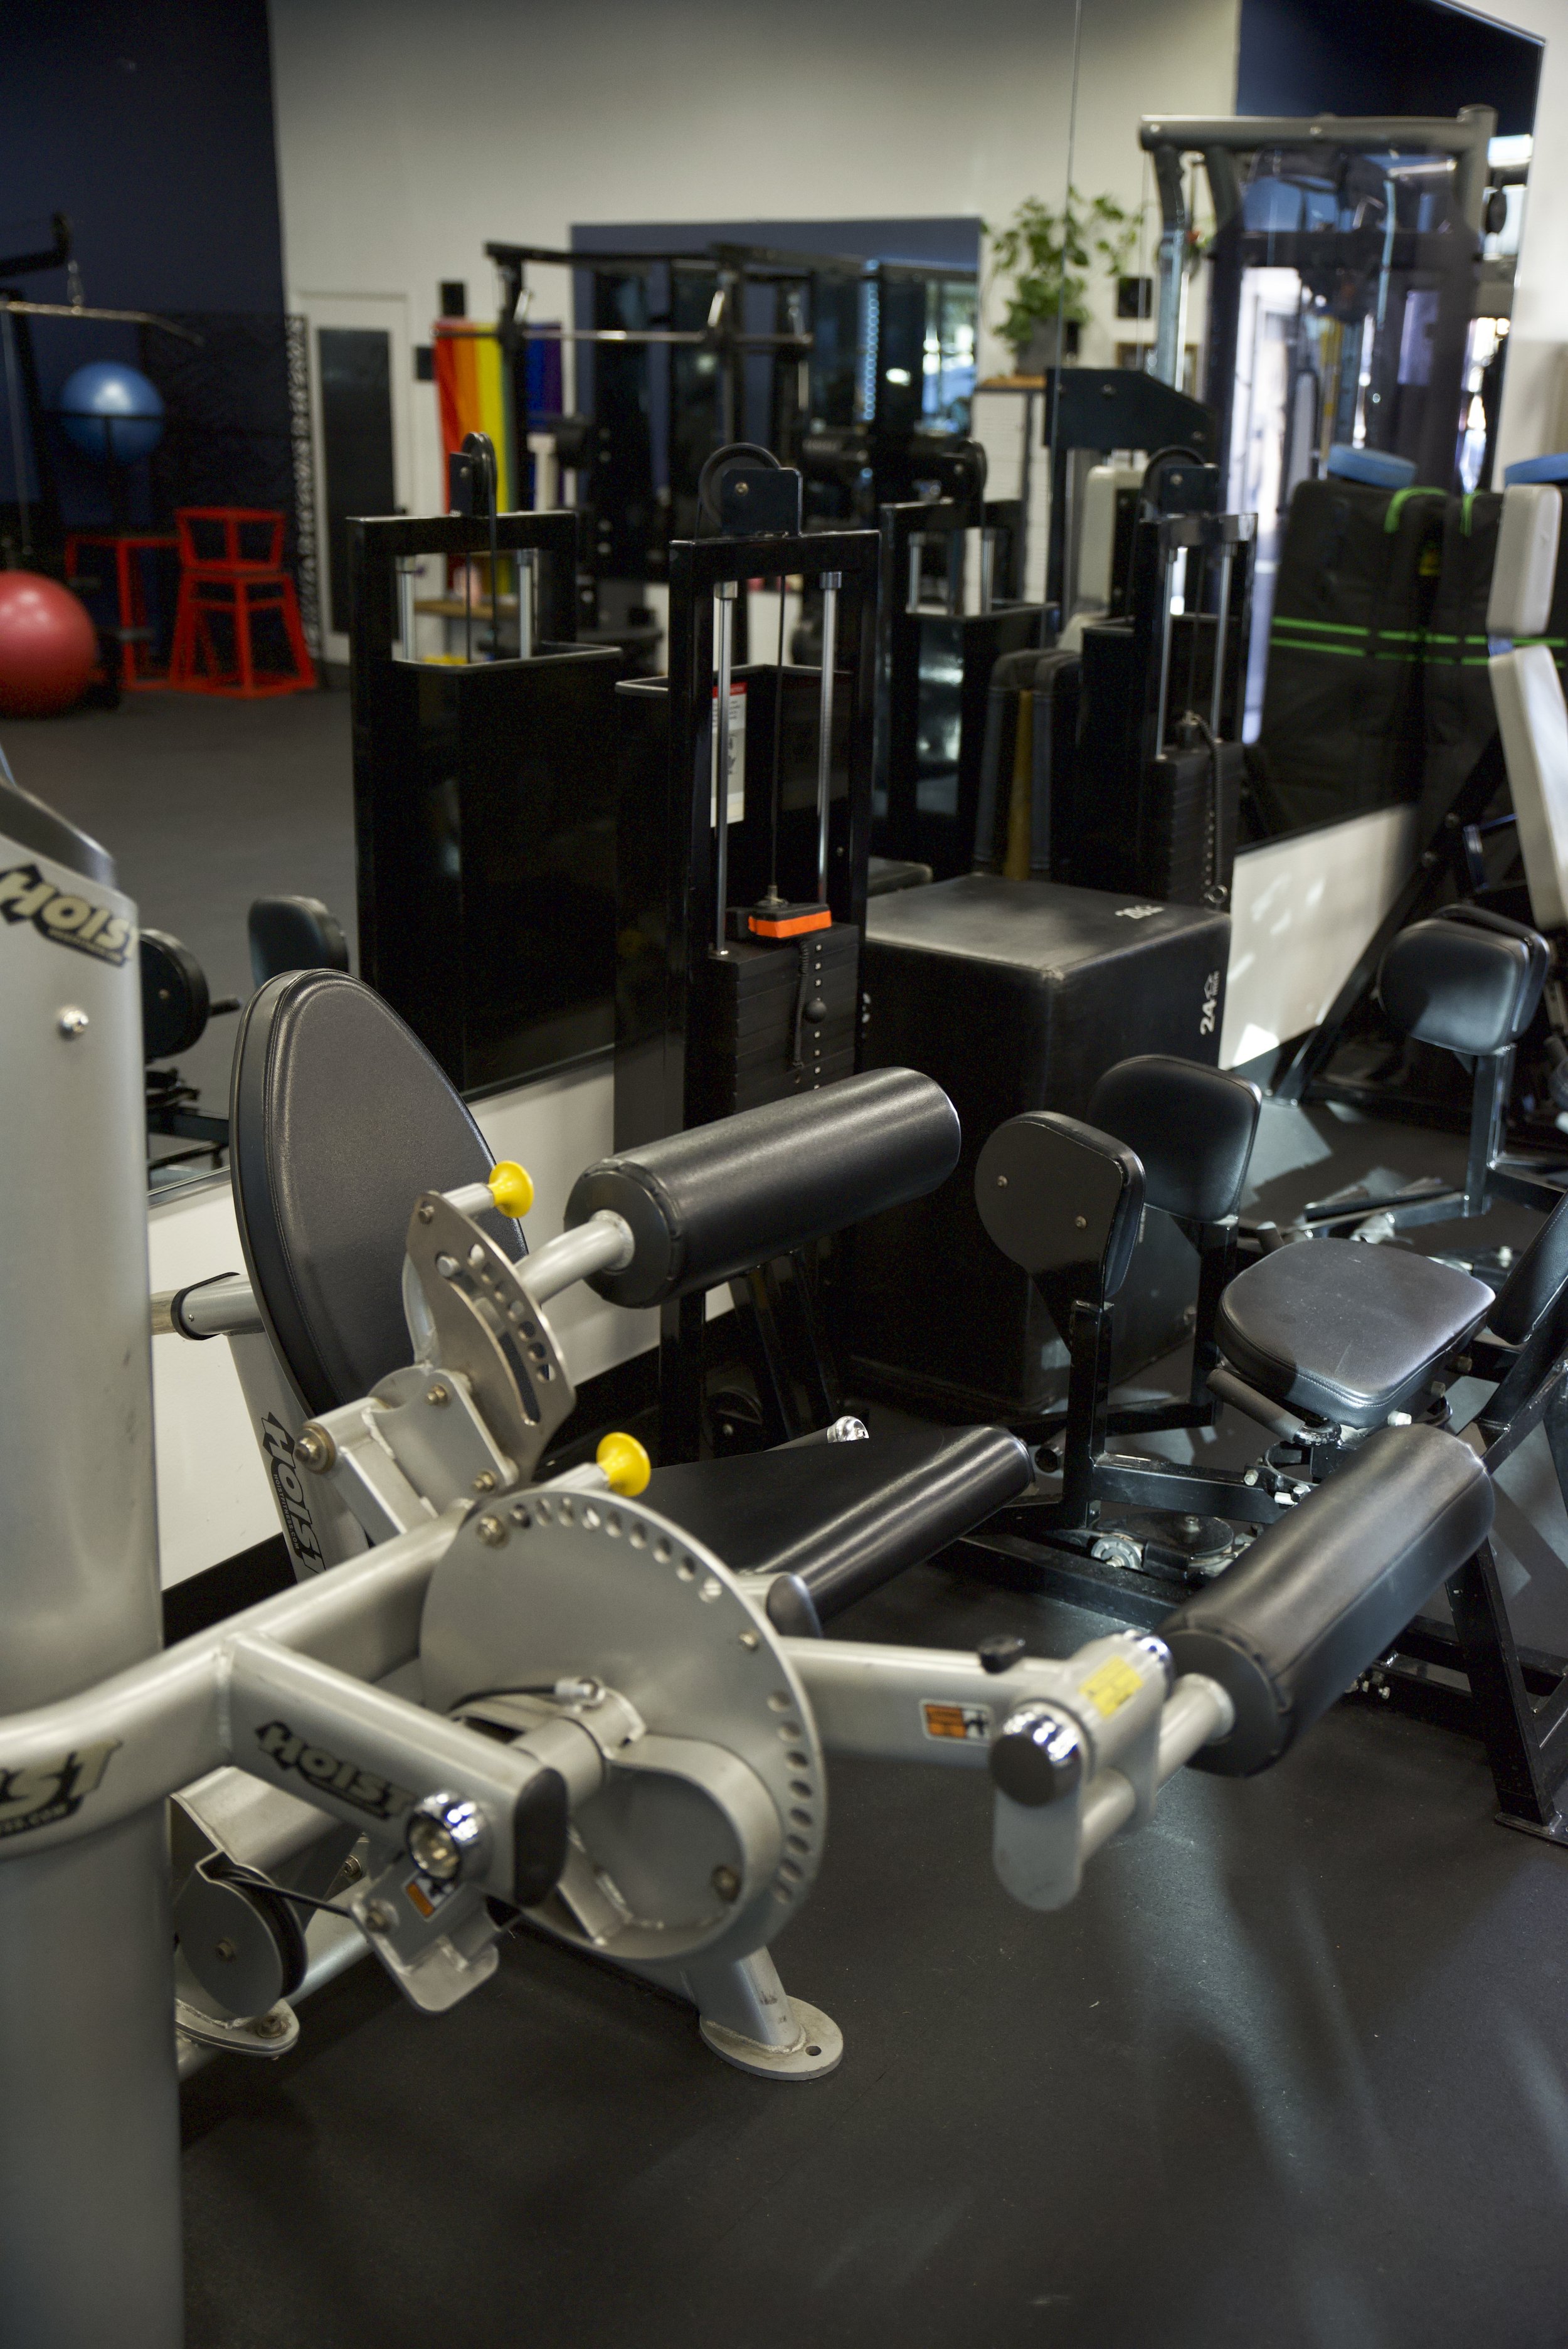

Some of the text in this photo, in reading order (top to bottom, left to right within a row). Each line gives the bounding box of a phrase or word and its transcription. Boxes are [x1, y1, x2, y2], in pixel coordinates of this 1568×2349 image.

[261, 1411, 326, 1575] HOIST
[273, 1473, 300, 1550] HOISTFITNESS.COM
[255, 1721, 418, 1819] HOIST
